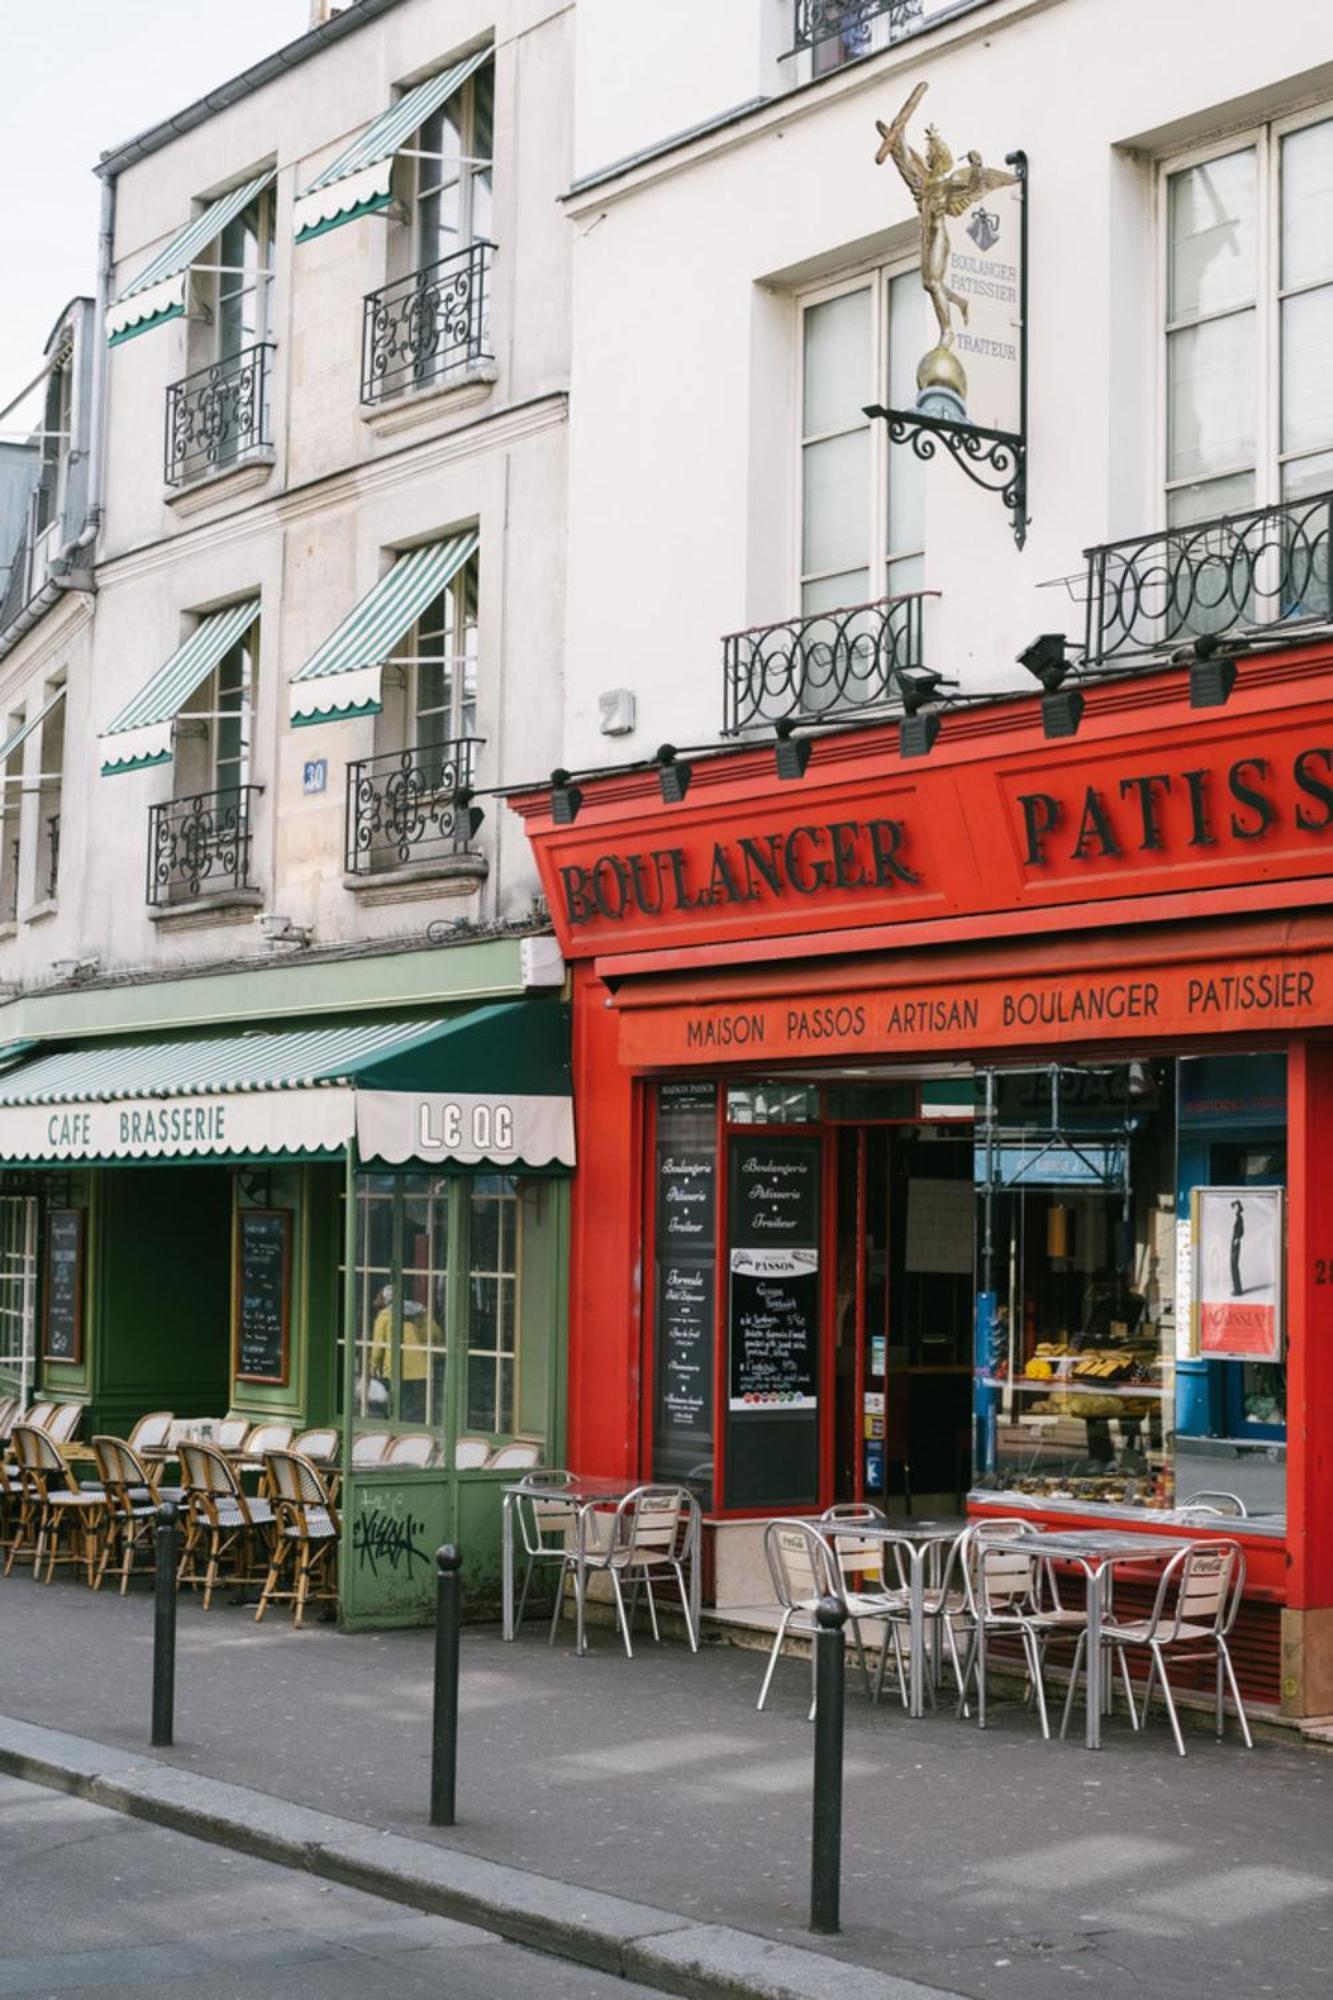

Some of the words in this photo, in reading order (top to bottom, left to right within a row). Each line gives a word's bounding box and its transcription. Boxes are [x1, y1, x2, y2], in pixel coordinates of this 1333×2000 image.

[950, 252, 1016, 283] BOULANGER
[950, 273, 1016, 303] PATISSIER
[956, 333, 1016, 361] TRAITEUR
[305, 763, 324, 790] 30
[559, 818, 923, 925] BOULANGER
[686, 1013, 765, 1048] MAISON
[786, 1005, 866, 1041] PASSOS
[887, 998, 979, 1034] ARTISAN
[1003, 983, 1160, 1026] BOULANGER
[1187, 971, 1315, 1014] PATISSIER
[47, 1113, 91, 1147] CAFE
[119, 1105, 226, 1145] BRASSERIE
[419, 1102, 463, 1149] LE
[472, 1103, 513, 1150] QG
[662, 1158, 712, 1177] Boulangerie
[742, 1157, 808, 1176] Boulangerie
